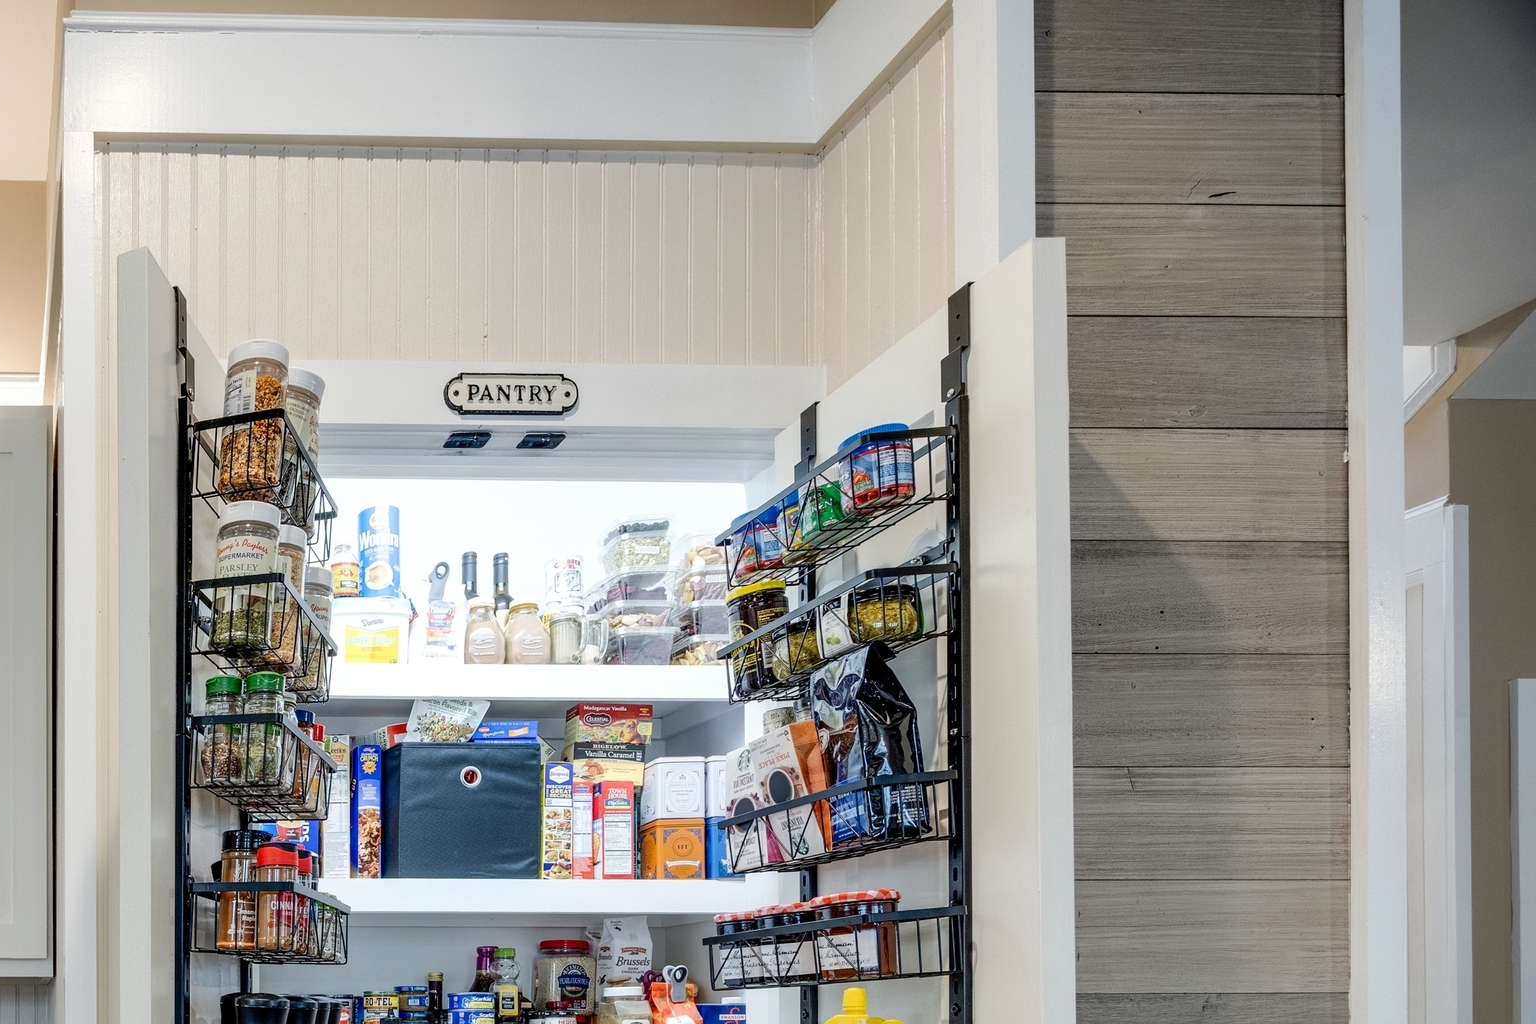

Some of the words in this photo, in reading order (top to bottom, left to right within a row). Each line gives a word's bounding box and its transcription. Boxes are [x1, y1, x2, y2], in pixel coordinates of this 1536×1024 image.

[467, 384, 557, 402] PANTRY
[359, 530, 400, 551] Wondra
[219, 553, 264, 563] SUPERMARKET
[219, 564, 258, 574] PARSLEY
[361, 618, 385, 627] Domino
[441, 700, 467, 713] Flavored
[467, 708, 477, 716] Bits
[607, 751, 635, 759] Caramel
[271, 900, 293, 910] CINNA
[616, 956, 651, 966] Brussels
